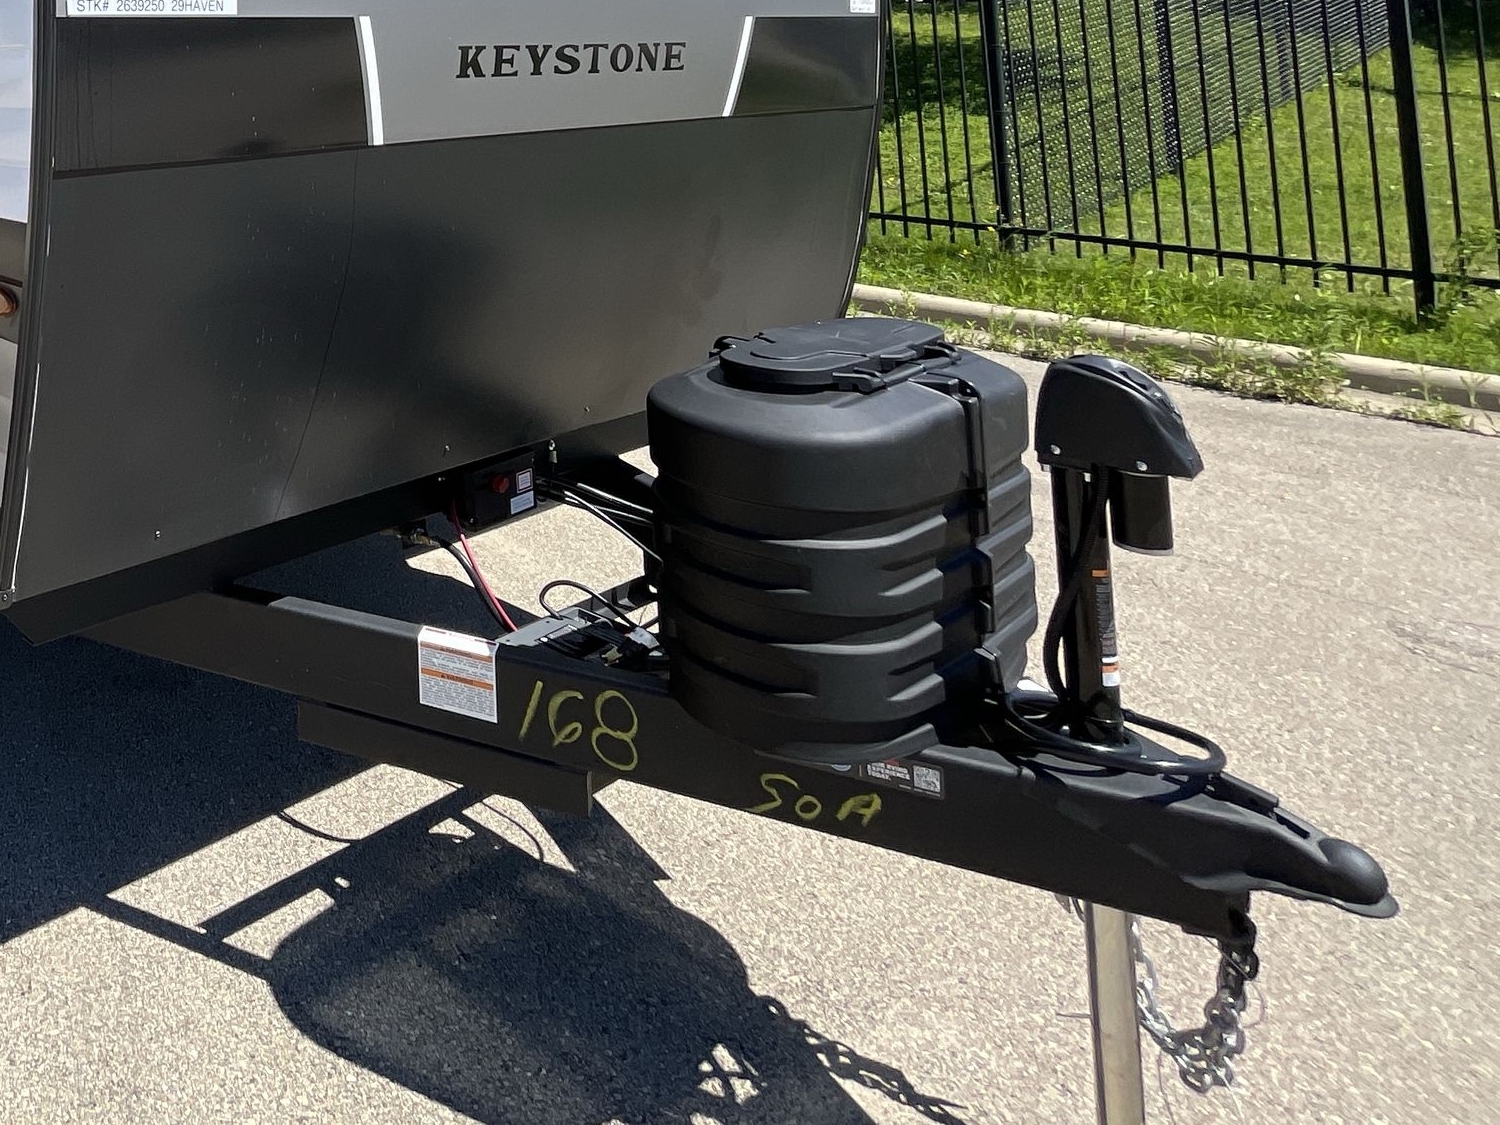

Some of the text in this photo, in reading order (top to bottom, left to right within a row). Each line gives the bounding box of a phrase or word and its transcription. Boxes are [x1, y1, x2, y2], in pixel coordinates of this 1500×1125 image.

[171, 0, 224, 12] 29HAVEN
[455, 41, 687, 78] KEYSTONE
[518, 679, 639, 771] 168
